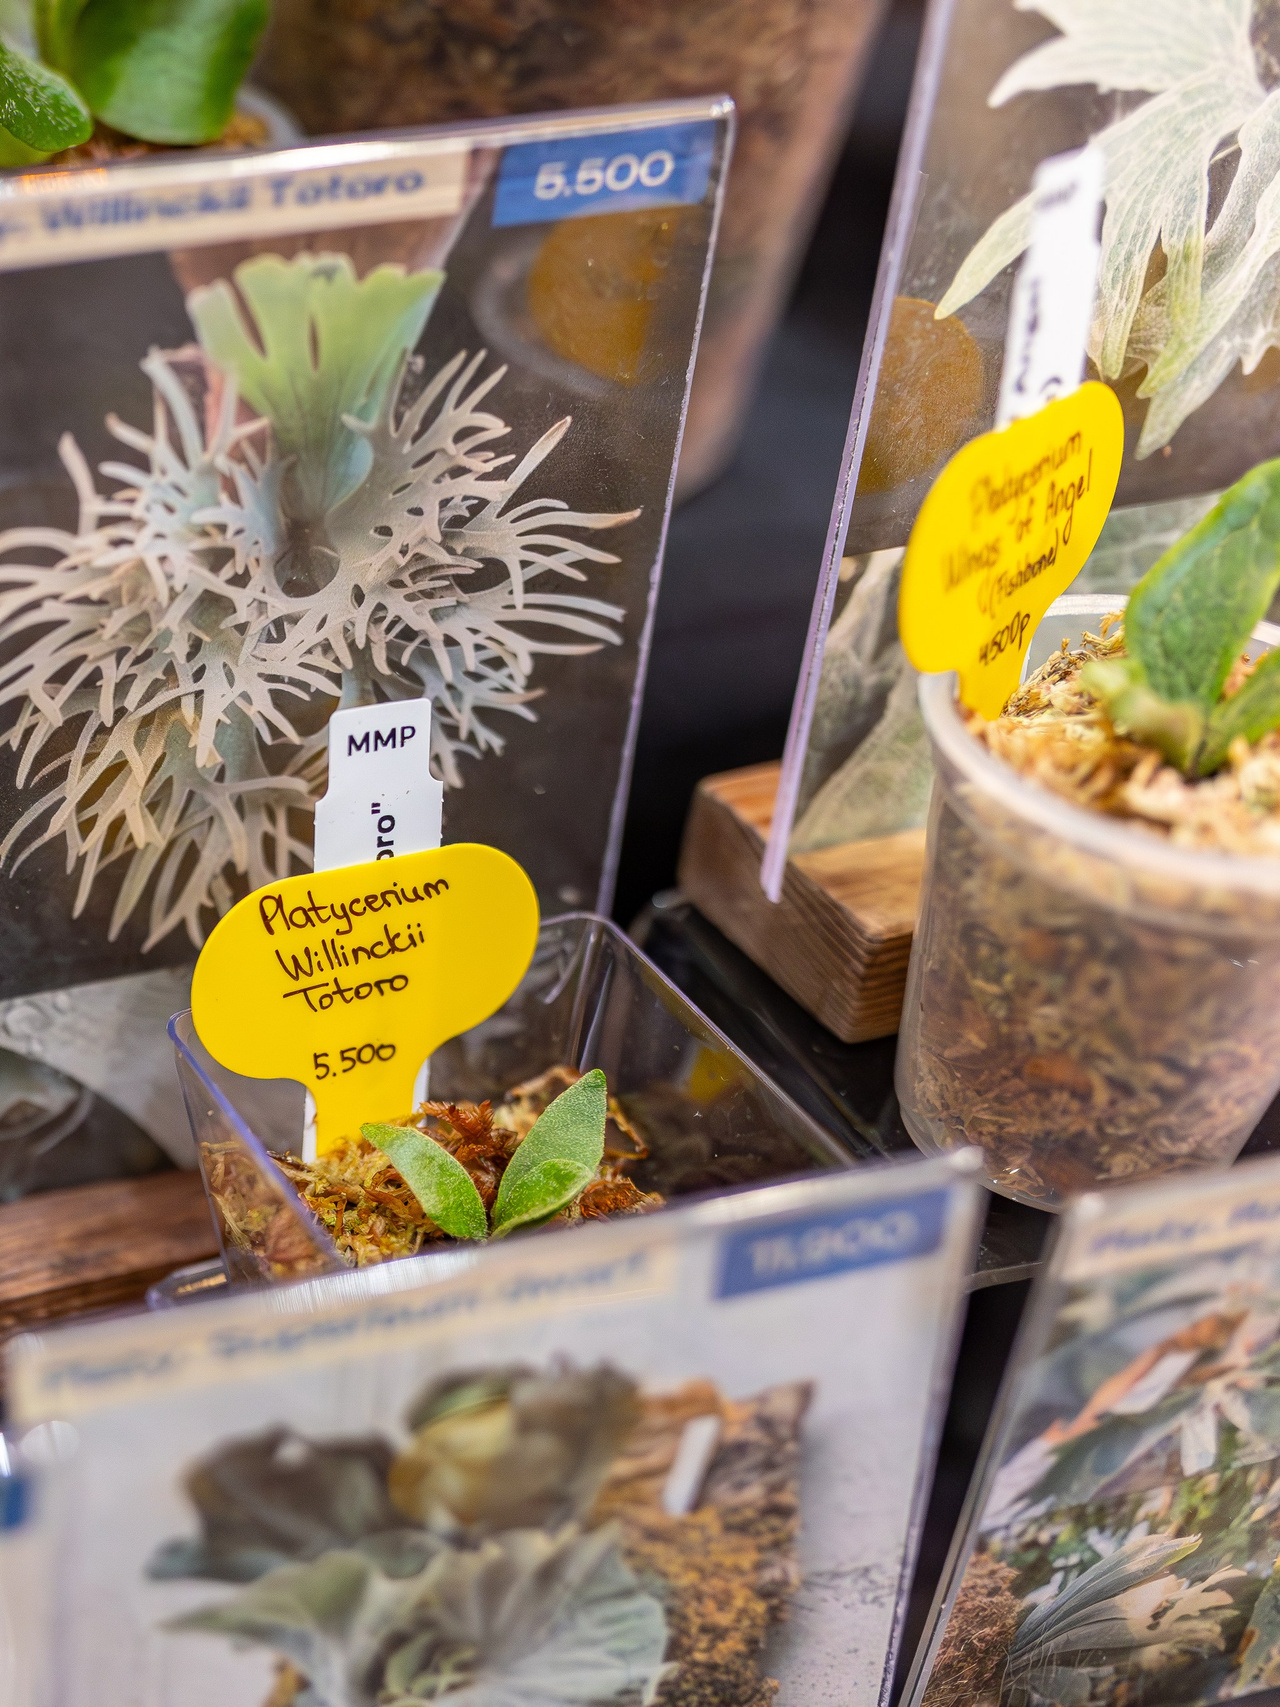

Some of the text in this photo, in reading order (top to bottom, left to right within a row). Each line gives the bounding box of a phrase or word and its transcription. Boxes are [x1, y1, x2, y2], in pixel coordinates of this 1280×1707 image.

[269, 171, 425, 207] Totoro
[533, 149, 675, 200] 5.500
[1044, 446, 1093, 546] Angel
[346, 724, 417, 757] MMP
[258, 877, 450, 936] Platycerium
[275, 922, 426, 982] Willinckii
[282, 973, 409, 1014] Totoro
[312, 1042, 397, 1081] 5.500
